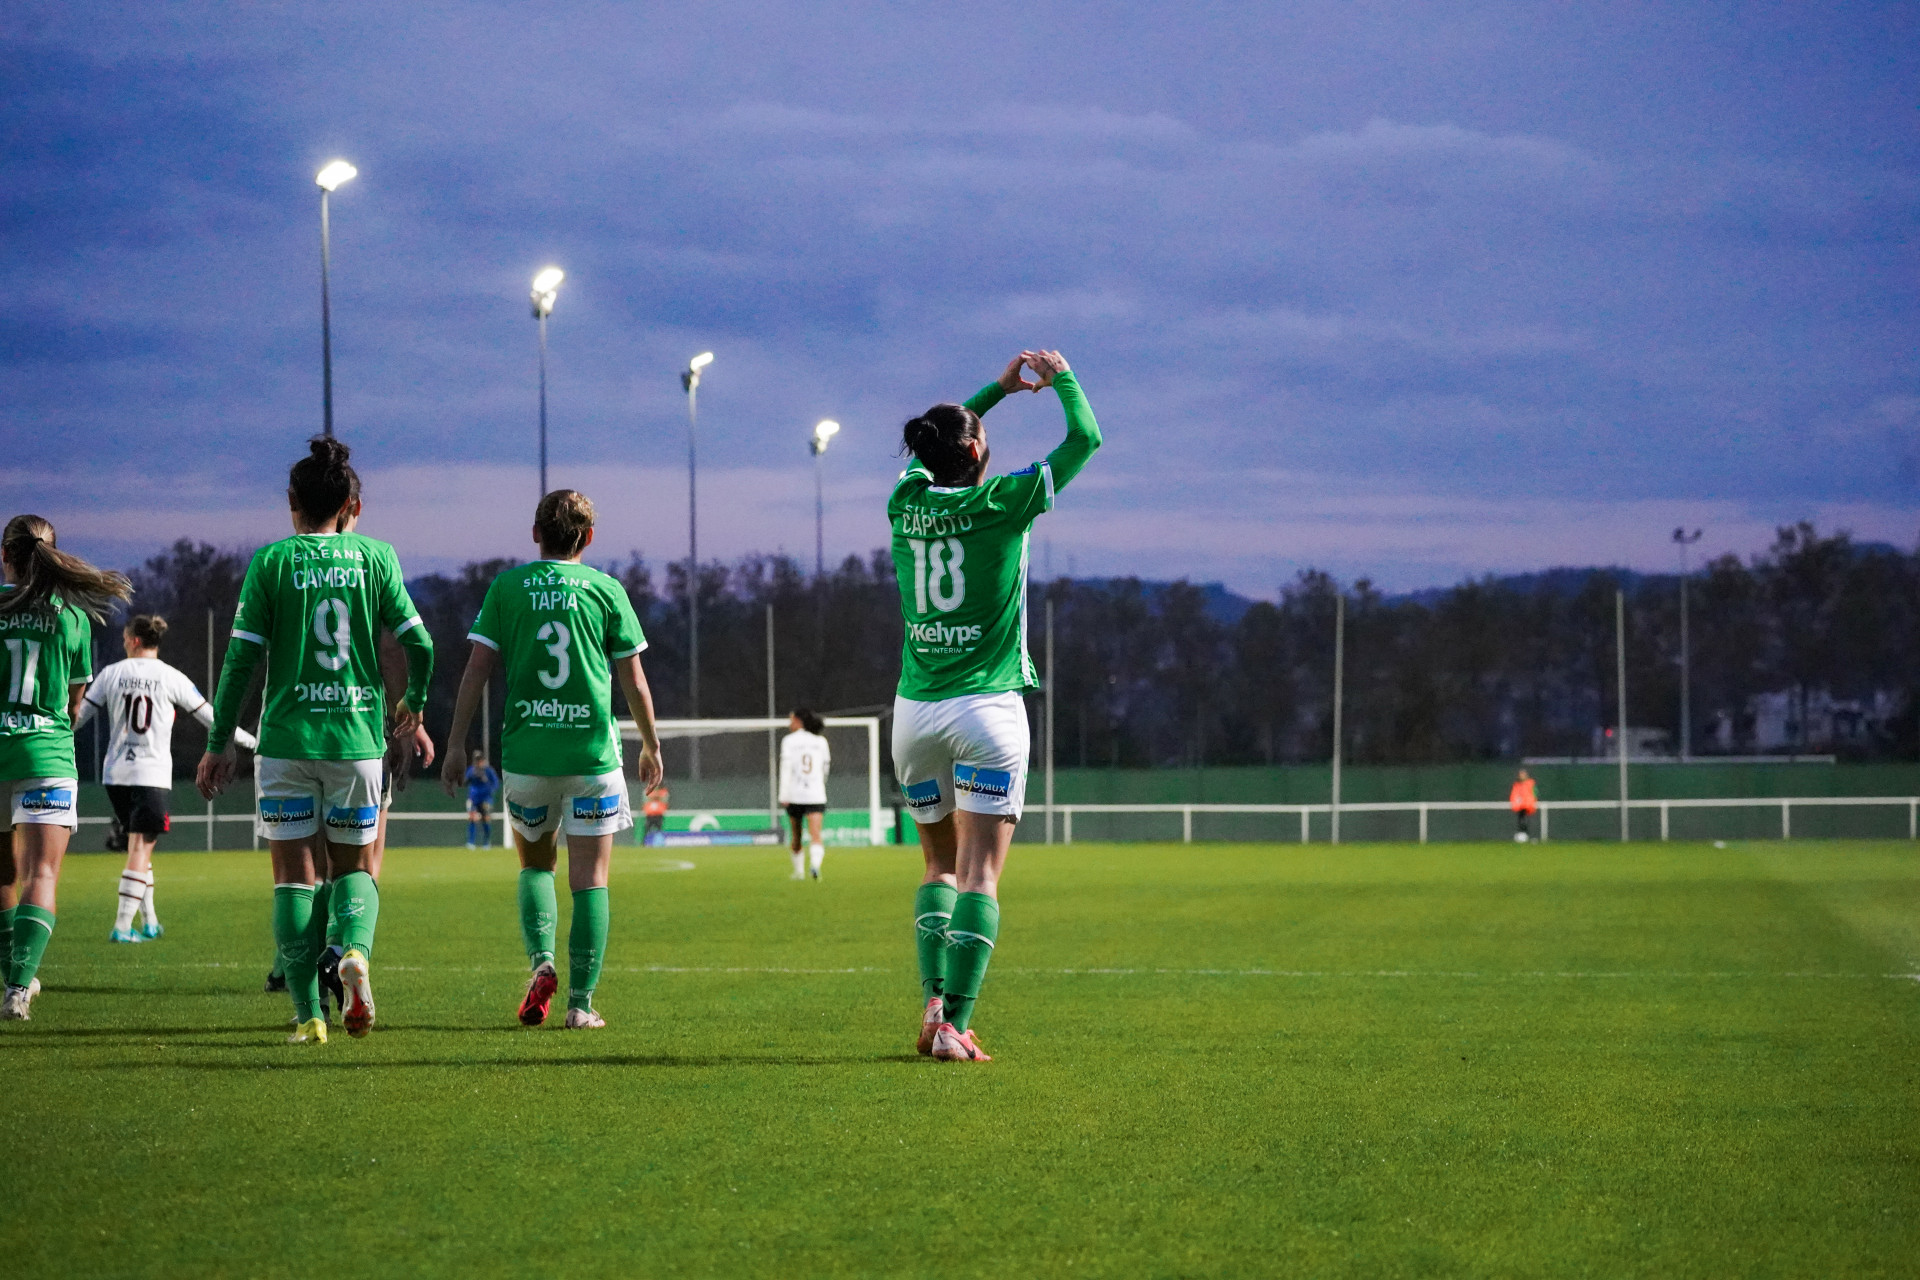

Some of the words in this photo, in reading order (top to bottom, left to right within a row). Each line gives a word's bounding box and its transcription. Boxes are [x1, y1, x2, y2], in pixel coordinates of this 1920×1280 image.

[902, 513, 973, 536] CAPUTO
[293, 567, 367, 590] CAMBOT
[907, 537, 965, 613] 18
[529, 591, 578, 611] TAPIA
[313, 597, 350, 671] 9
[913, 622, 982, 647] Kelyps
[536, 621, 571, 690] 3
[4, 638, 42, 705] 11
[309, 681, 373, 706] Kelyps
[122, 692, 153, 734] 10
[531, 698, 591, 722] Kelyps
[545, 722, 573, 730] INTERIM
[802, 753, 813, 775] 9
